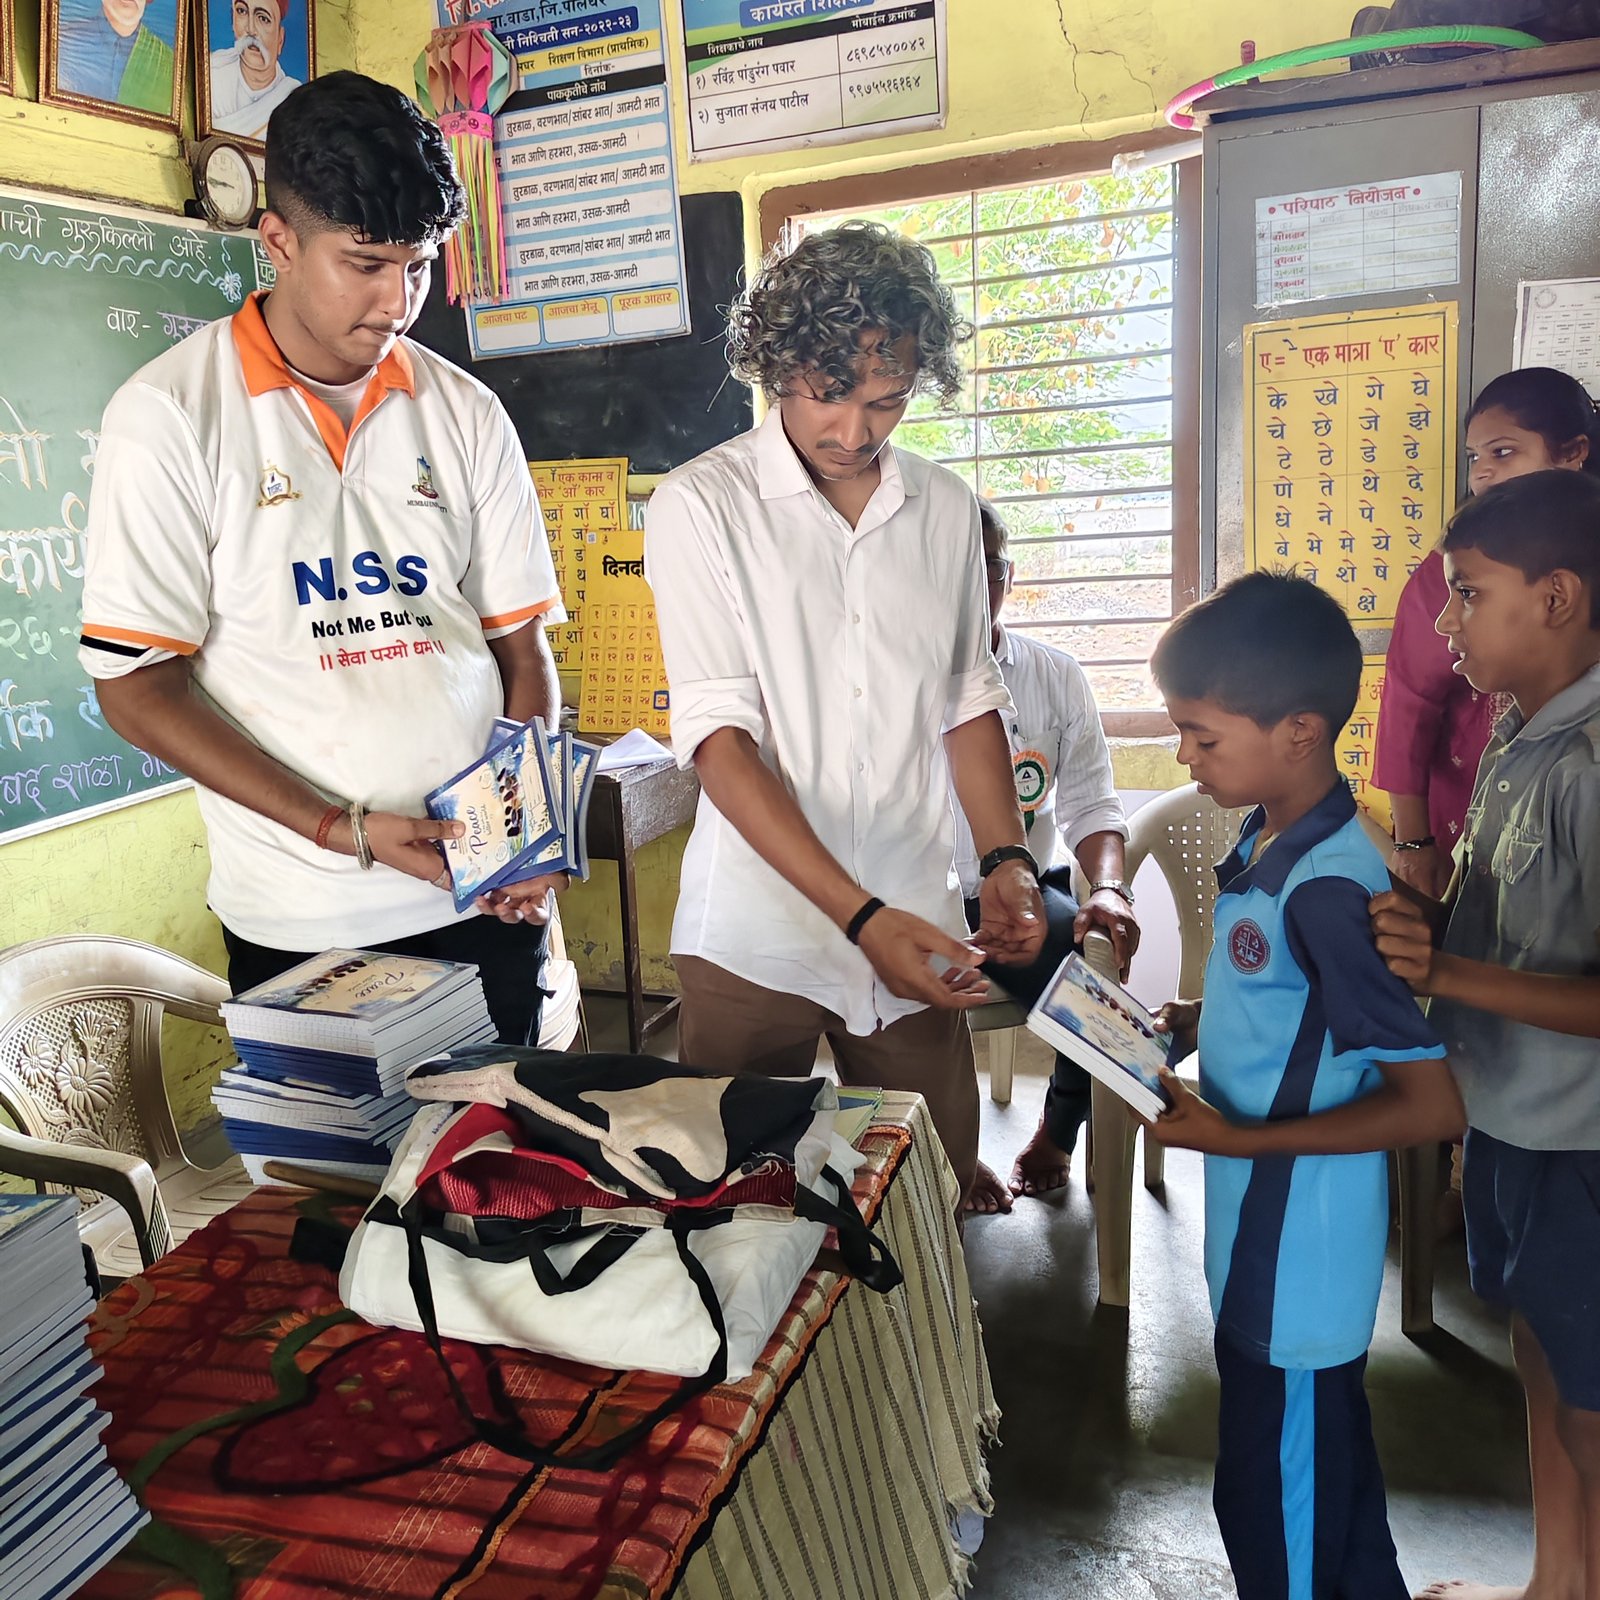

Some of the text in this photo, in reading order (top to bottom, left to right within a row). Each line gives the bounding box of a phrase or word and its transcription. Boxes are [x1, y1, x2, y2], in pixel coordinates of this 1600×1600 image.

[549, 37, 648, 66] शिक्षण विभाग (प्राथमिक)
[846, 37, 925, 62] ८६९८५४००४२
[737, 61, 769, 84] पांडुरंग
[772, 60, 796, 75] पवार
[617, 97, 642, 114] आमटी
[644, 96, 660, 109] भात
[698, 90, 809, 124] २) सुजाता संजय पाटील
[511, 152, 526, 165] भात
[528, 147, 547, 162] आणि
[622, 162, 647, 179] आमटी
[649, 162, 665, 176] भात
[1344, 186, 1411, 206] नियोजन
[516, 217, 531, 230] भात
[532, 211, 551, 226] आणि
[628, 229, 653, 245] आमटी
[654, 229, 671, 241] भात
[524, 281, 539, 292] भात
[540, 274, 558, 289] आणि
[619, 292, 673, 311] पूरक आहार
[1302, 346, 1330, 368] एक
[1334, 342, 1371, 363] मात्रा
[1407, 335, 1440, 356] कार
[1267, 372, 1430, 410] के खे गे घे
[1266, 403, 1431, 440] चे छे जे झे
[1277, 446, 1292, 470] टे
[1317, 442, 1334, 467] ठे
[1360, 438, 1376, 463] डे
[558, 473, 575, 485] एक
[584, 486, 606, 497] कार
[1273, 465, 1424, 499] णे ते थे दे
[1276, 496, 1423, 528] धे ने पे फे
[1306, 532, 1323, 555] भे
[1339, 530, 1355, 553] मे
[1371, 528, 1391, 551] ये
[1405, 526, 1422, 550] रे
[602, 554, 645, 578] दिनद
[1336, 559, 1357, 582] शे
[1373, 557, 1389, 581] षे
[1358, 587, 1377, 613] क्षे
[311, 609, 433, 639] Not Me But ou
[337, 639, 409, 668] सेवा परमो
[1349, 716, 1373, 739] गो
[1343, 744, 1370, 766] जो
[469, 804, 488, 855] Peace
